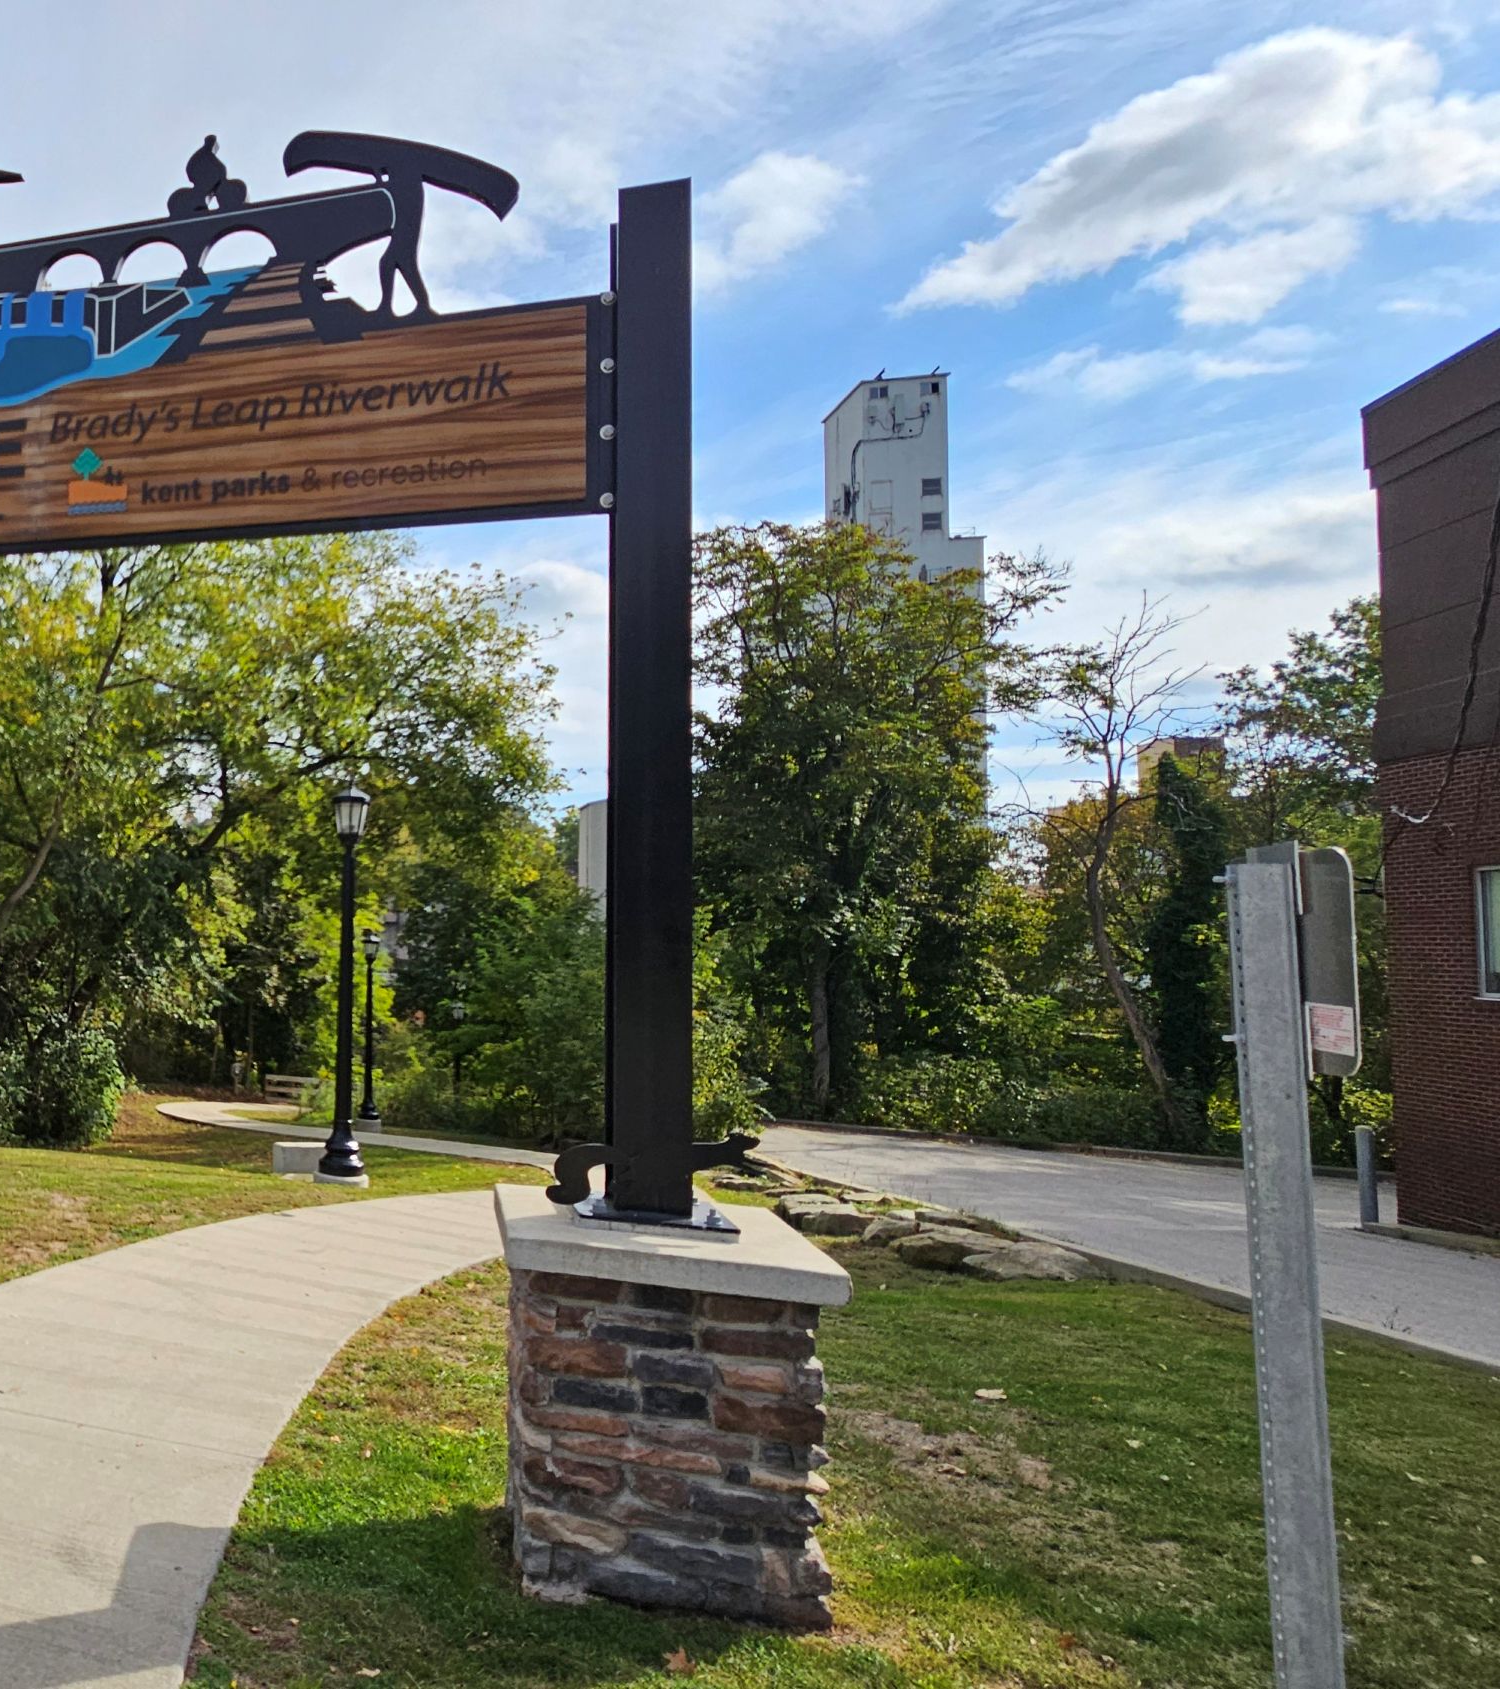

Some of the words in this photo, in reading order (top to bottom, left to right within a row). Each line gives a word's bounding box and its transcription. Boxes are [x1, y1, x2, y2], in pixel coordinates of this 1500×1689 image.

[51, 401, 182, 444] Brady's
[191, 395, 288, 432] Leap
[299, 361, 514, 418] Riverwalk
[141, 479, 201, 504] kent
[212, 471, 291, 503] parks
[301, 467, 322, 493] &
[331, 456, 488, 490] recreation
